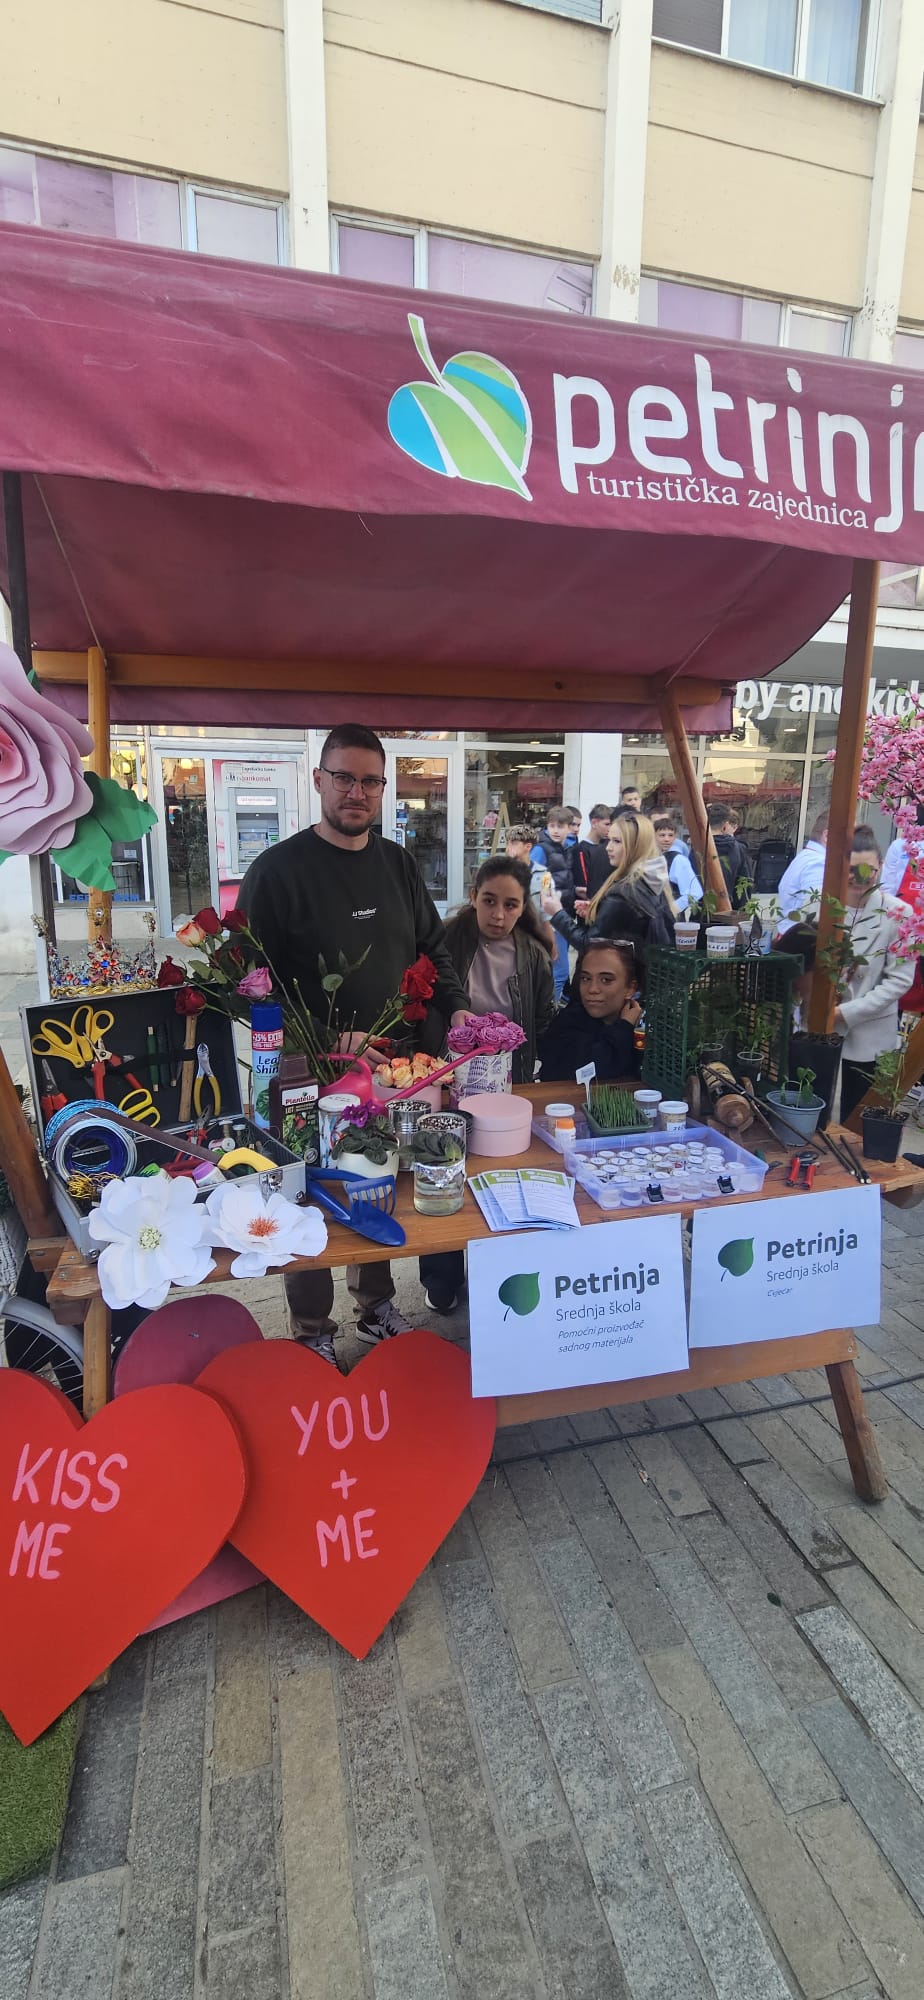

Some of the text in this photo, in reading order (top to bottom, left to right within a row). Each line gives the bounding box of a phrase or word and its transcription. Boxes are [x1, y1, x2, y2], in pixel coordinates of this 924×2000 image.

[553, 354, 924, 532] petrinj
[586, 472, 869, 529] turistička zajednica
[256, 1065, 279, 1074] Shin
[767, 1228, 858, 1261] Petrinja
[555, 1262, 660, 1298] Petrinja
[766, 1259, 839, 1282] Srednja škola
[556, 1298, 641, 1321] Srednja škola
[558, 1319, 645, 1339] Pomoćni proizvođač
[558, 1334, 634, 1353] sadnog materijala
[290, 1389, 391, 1456] YOU
[12, 1443, 128, 1513] KISS
[331, 1469, 358, 1499] +
[9, 1520, 71, 1580] ME
[316, 1508, 380, 1568] ME
